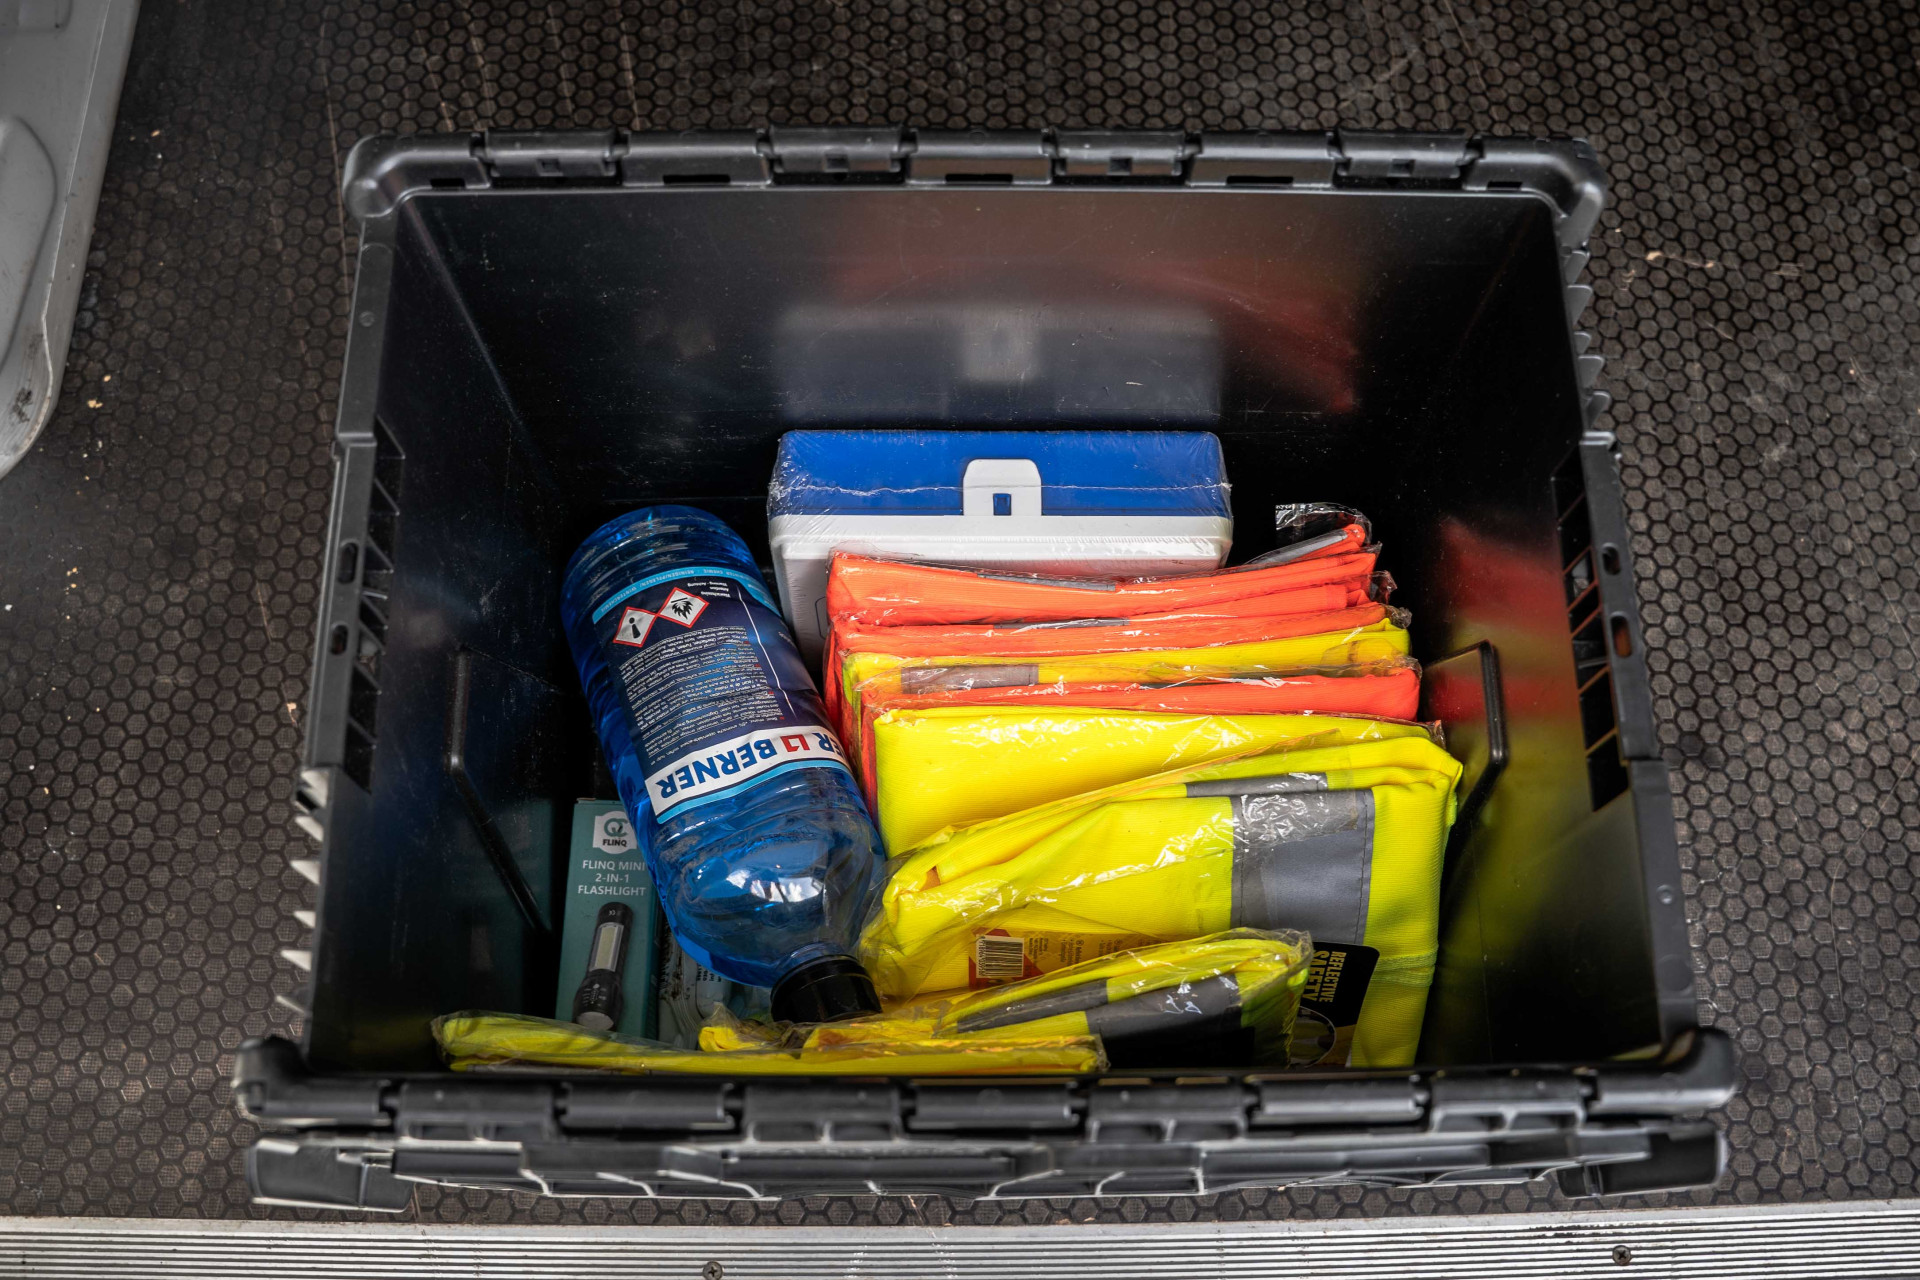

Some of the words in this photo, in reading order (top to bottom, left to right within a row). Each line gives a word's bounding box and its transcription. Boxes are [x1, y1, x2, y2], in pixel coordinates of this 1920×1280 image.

[655, 738, 778, 799] BERNER
[602, 838, 628, 848] FLINQ
[582, 859, 616, 871] FLINQ
[618, 861, 646, 872] MINI
[595, 873, 630, 883] 2-IN-1
[577, 884, 647, 897] FLASHLIGHT
[1302, 950, 1330, 1002] SAFETY
[1319, 951, 1347, 1003] REFLECTIVE
